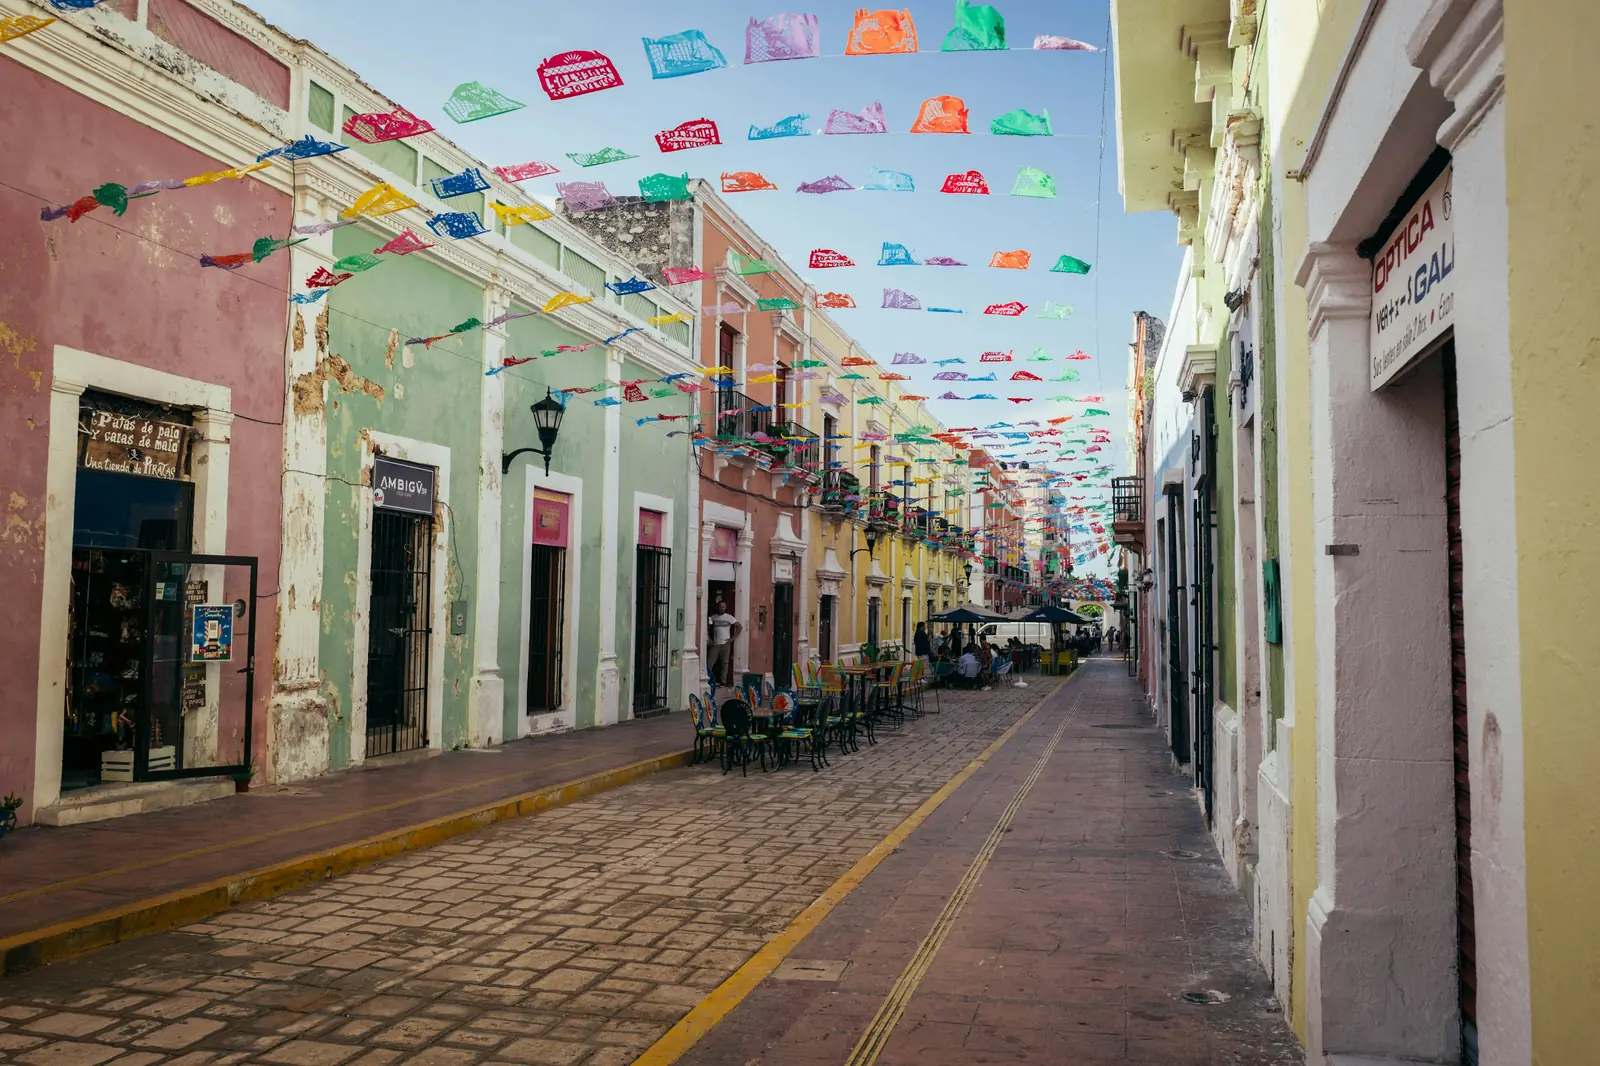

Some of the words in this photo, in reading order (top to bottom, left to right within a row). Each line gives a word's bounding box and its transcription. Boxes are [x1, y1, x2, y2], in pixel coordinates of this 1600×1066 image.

[1375, 200, 1434, 294] OPTICA
[104, 432, 134, 446] caras
[139, 434, 151, 448] de
[141, 421, 153, 434] de
[158, 425, 180, 440] palo
[85, 452, 103, 470] Una
[104, 458, 130, 473] tienda
[133, 462, 143, 474] de
